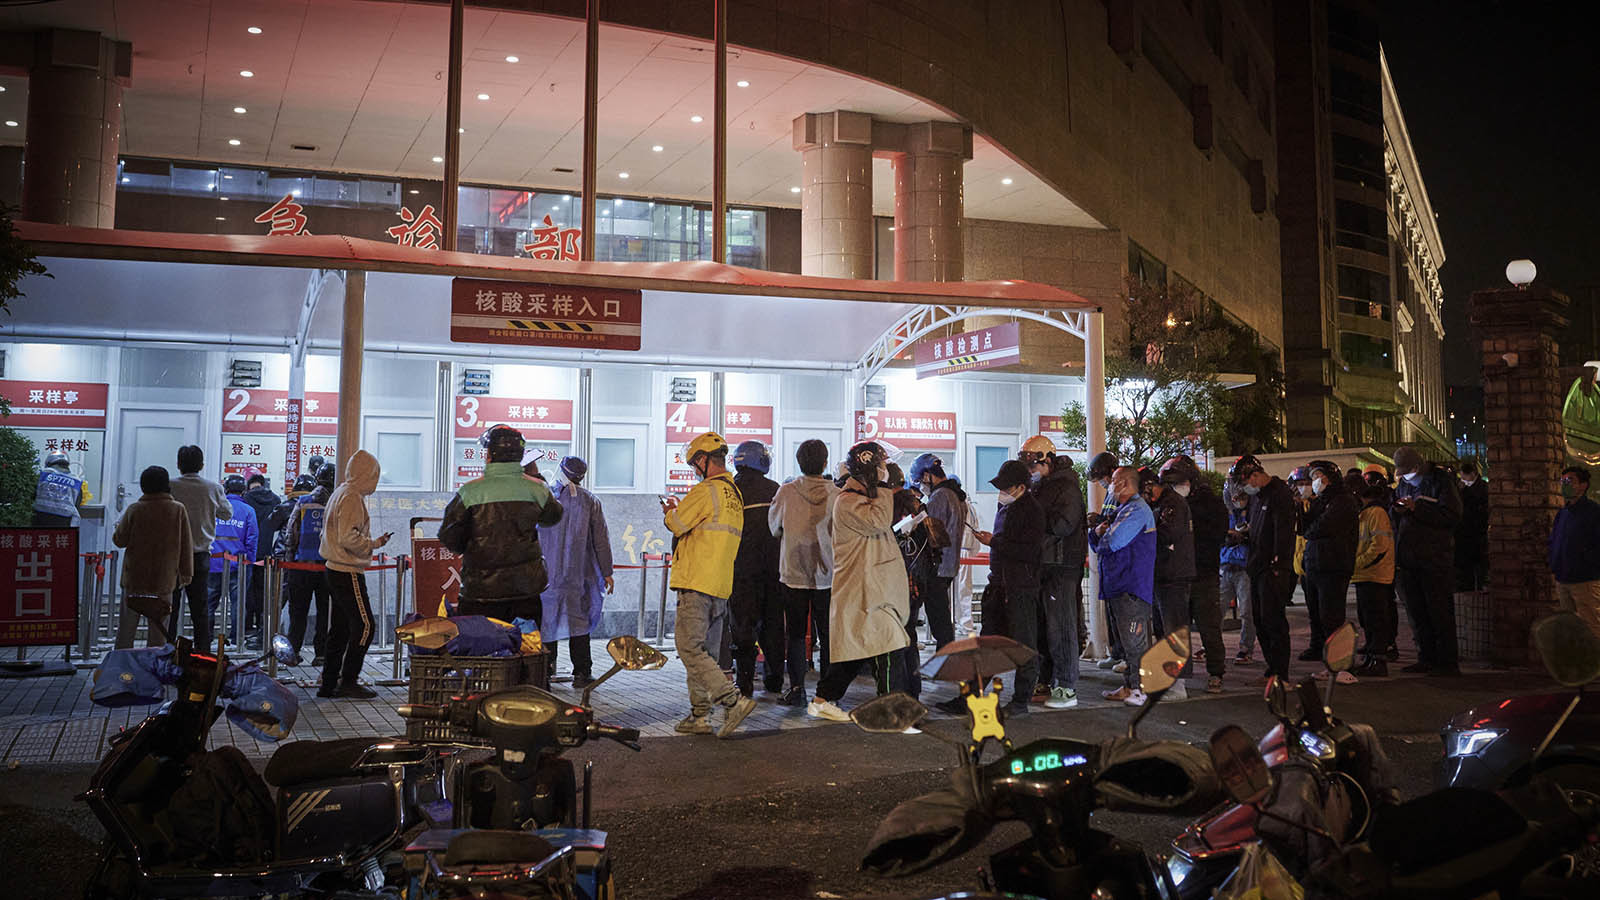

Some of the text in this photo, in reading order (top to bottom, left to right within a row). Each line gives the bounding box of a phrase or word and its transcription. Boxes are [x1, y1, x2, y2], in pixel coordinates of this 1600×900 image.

[475, 290, 620, 318] 核酸采样入口
[934, 331, 993, 360] 核酸检测点
[28, 389, 79, 405] 采样亭
[224, 389, 251, 422] 2
[274, 398, 320, 413] 采亭
[456, 396, 479, 428] 3
[508, 405, 549, 419] 采样亭
[666, 403, 688, 433] 4
[865, 410, 879, 439] 5
[45, 438, 89, 452] 采样处
[231, 443, 261, 456] 登记
[1, 534, 70, 548] 核酸采样
[15, 551, 53, 617] 出口
